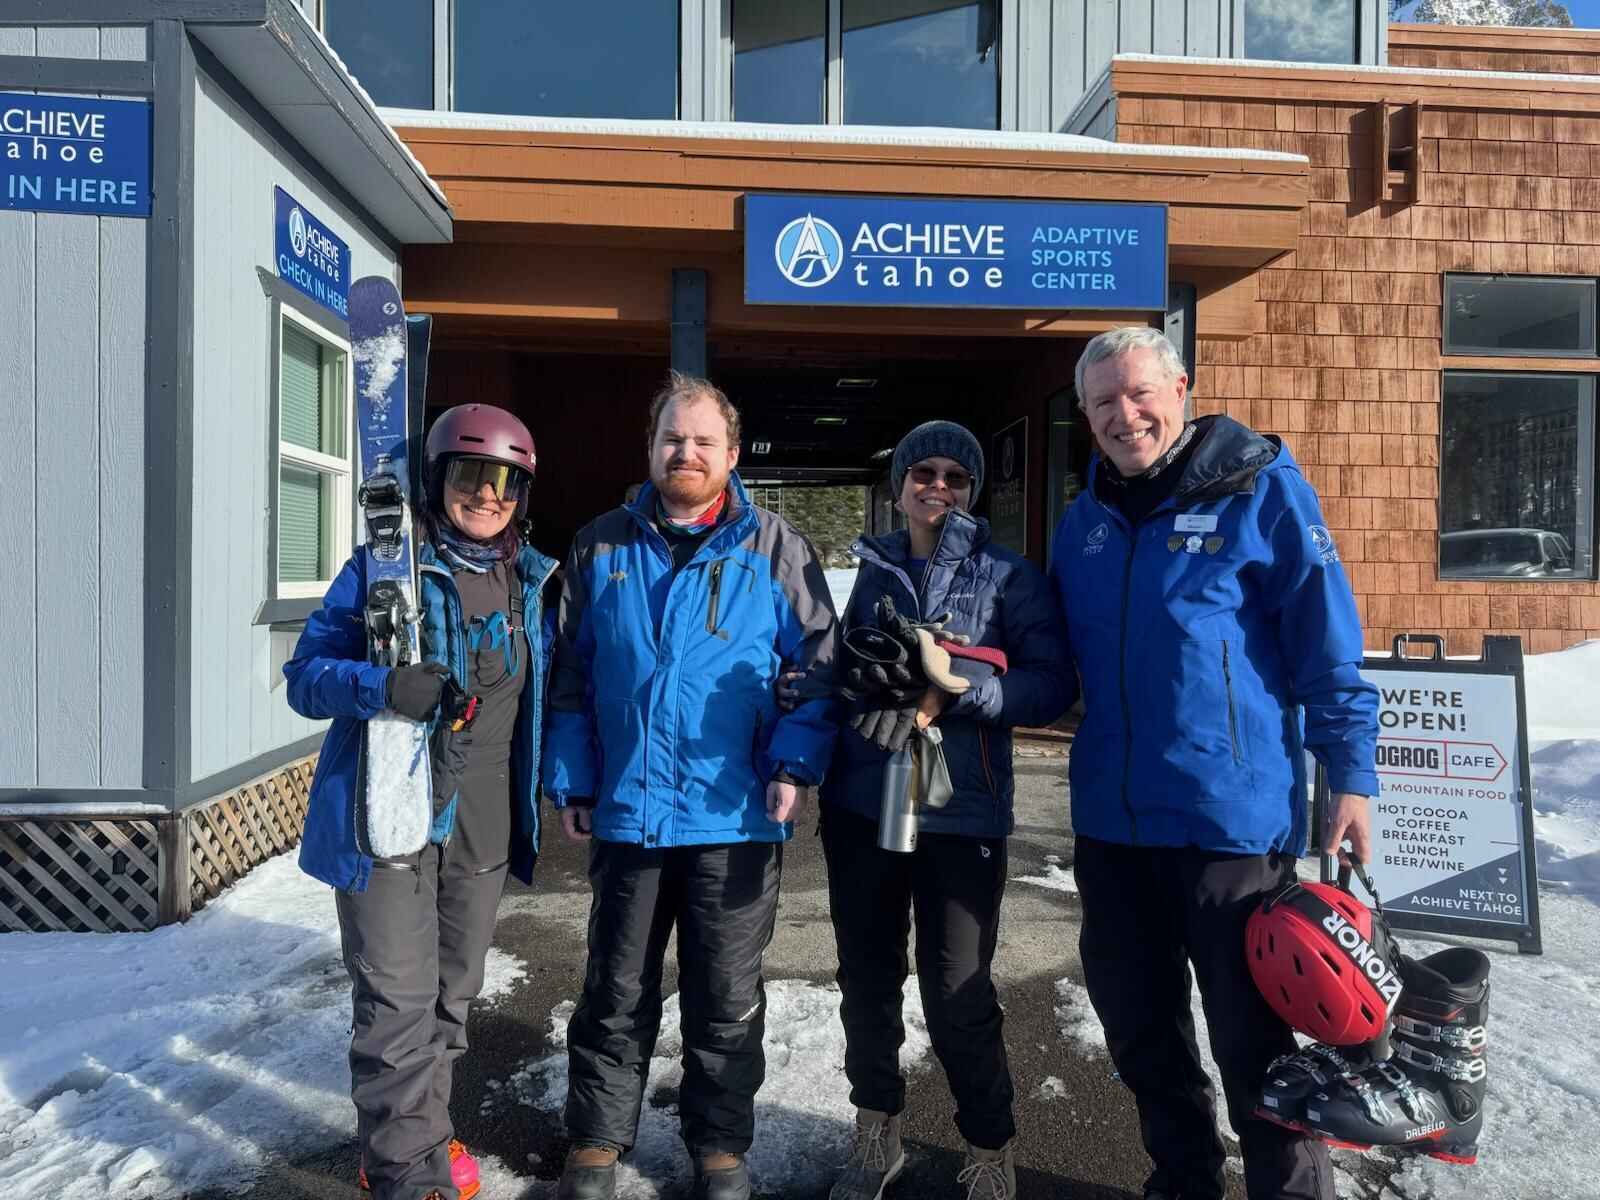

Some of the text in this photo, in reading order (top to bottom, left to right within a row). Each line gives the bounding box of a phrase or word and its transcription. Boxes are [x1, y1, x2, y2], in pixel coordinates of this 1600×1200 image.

[0, 109, 105, 138] CHIEVE
[7, 136, 104, 163] ahoe
[9, 174, 137, 205] IN HERE
[306, 224, 340, 264] ACHIEVE
[850, 222, 1005, 256] ACHIEVE
[1031, 226, 1140, 247] ADAPTIVE
[308, 247, 340, 282] tahoe
[1031, 249, 1113, 268] SPORTS
[854, 256, 1004, 289] tahoe
[1031, 271, 1117, 291] CENTER
[279, 253, 349, 316] CHECK IN HERE
[1381, 688, 1464, 708] WE'RE
[1379, 710, 1467, 732] OPEN!
[1375, 744, 1496, 770] OGROG CAFE
[1391, 783, 1464, 798] MOUNTAIN
[1468, 788, 1507, 800] FOOD
[1377, 803, 1469, 820] HOT COCOA
[1395, 817, 1451, 831] COFFEE
[1382, 829, 1466, 846] BREAKFAST
[1399, 844, 1449, 857] LUNCH
[1384, 855, 1465, 871] BEER/WINE
[1411, 895, 1522, 916] ACHIEVE TAHOE
[1459, 888, 1518, 904] NEXT TO
[1322, 910, 1404, 1002] ZIONOR
[1406, 1120, 1446, 1140] DALBELLO
